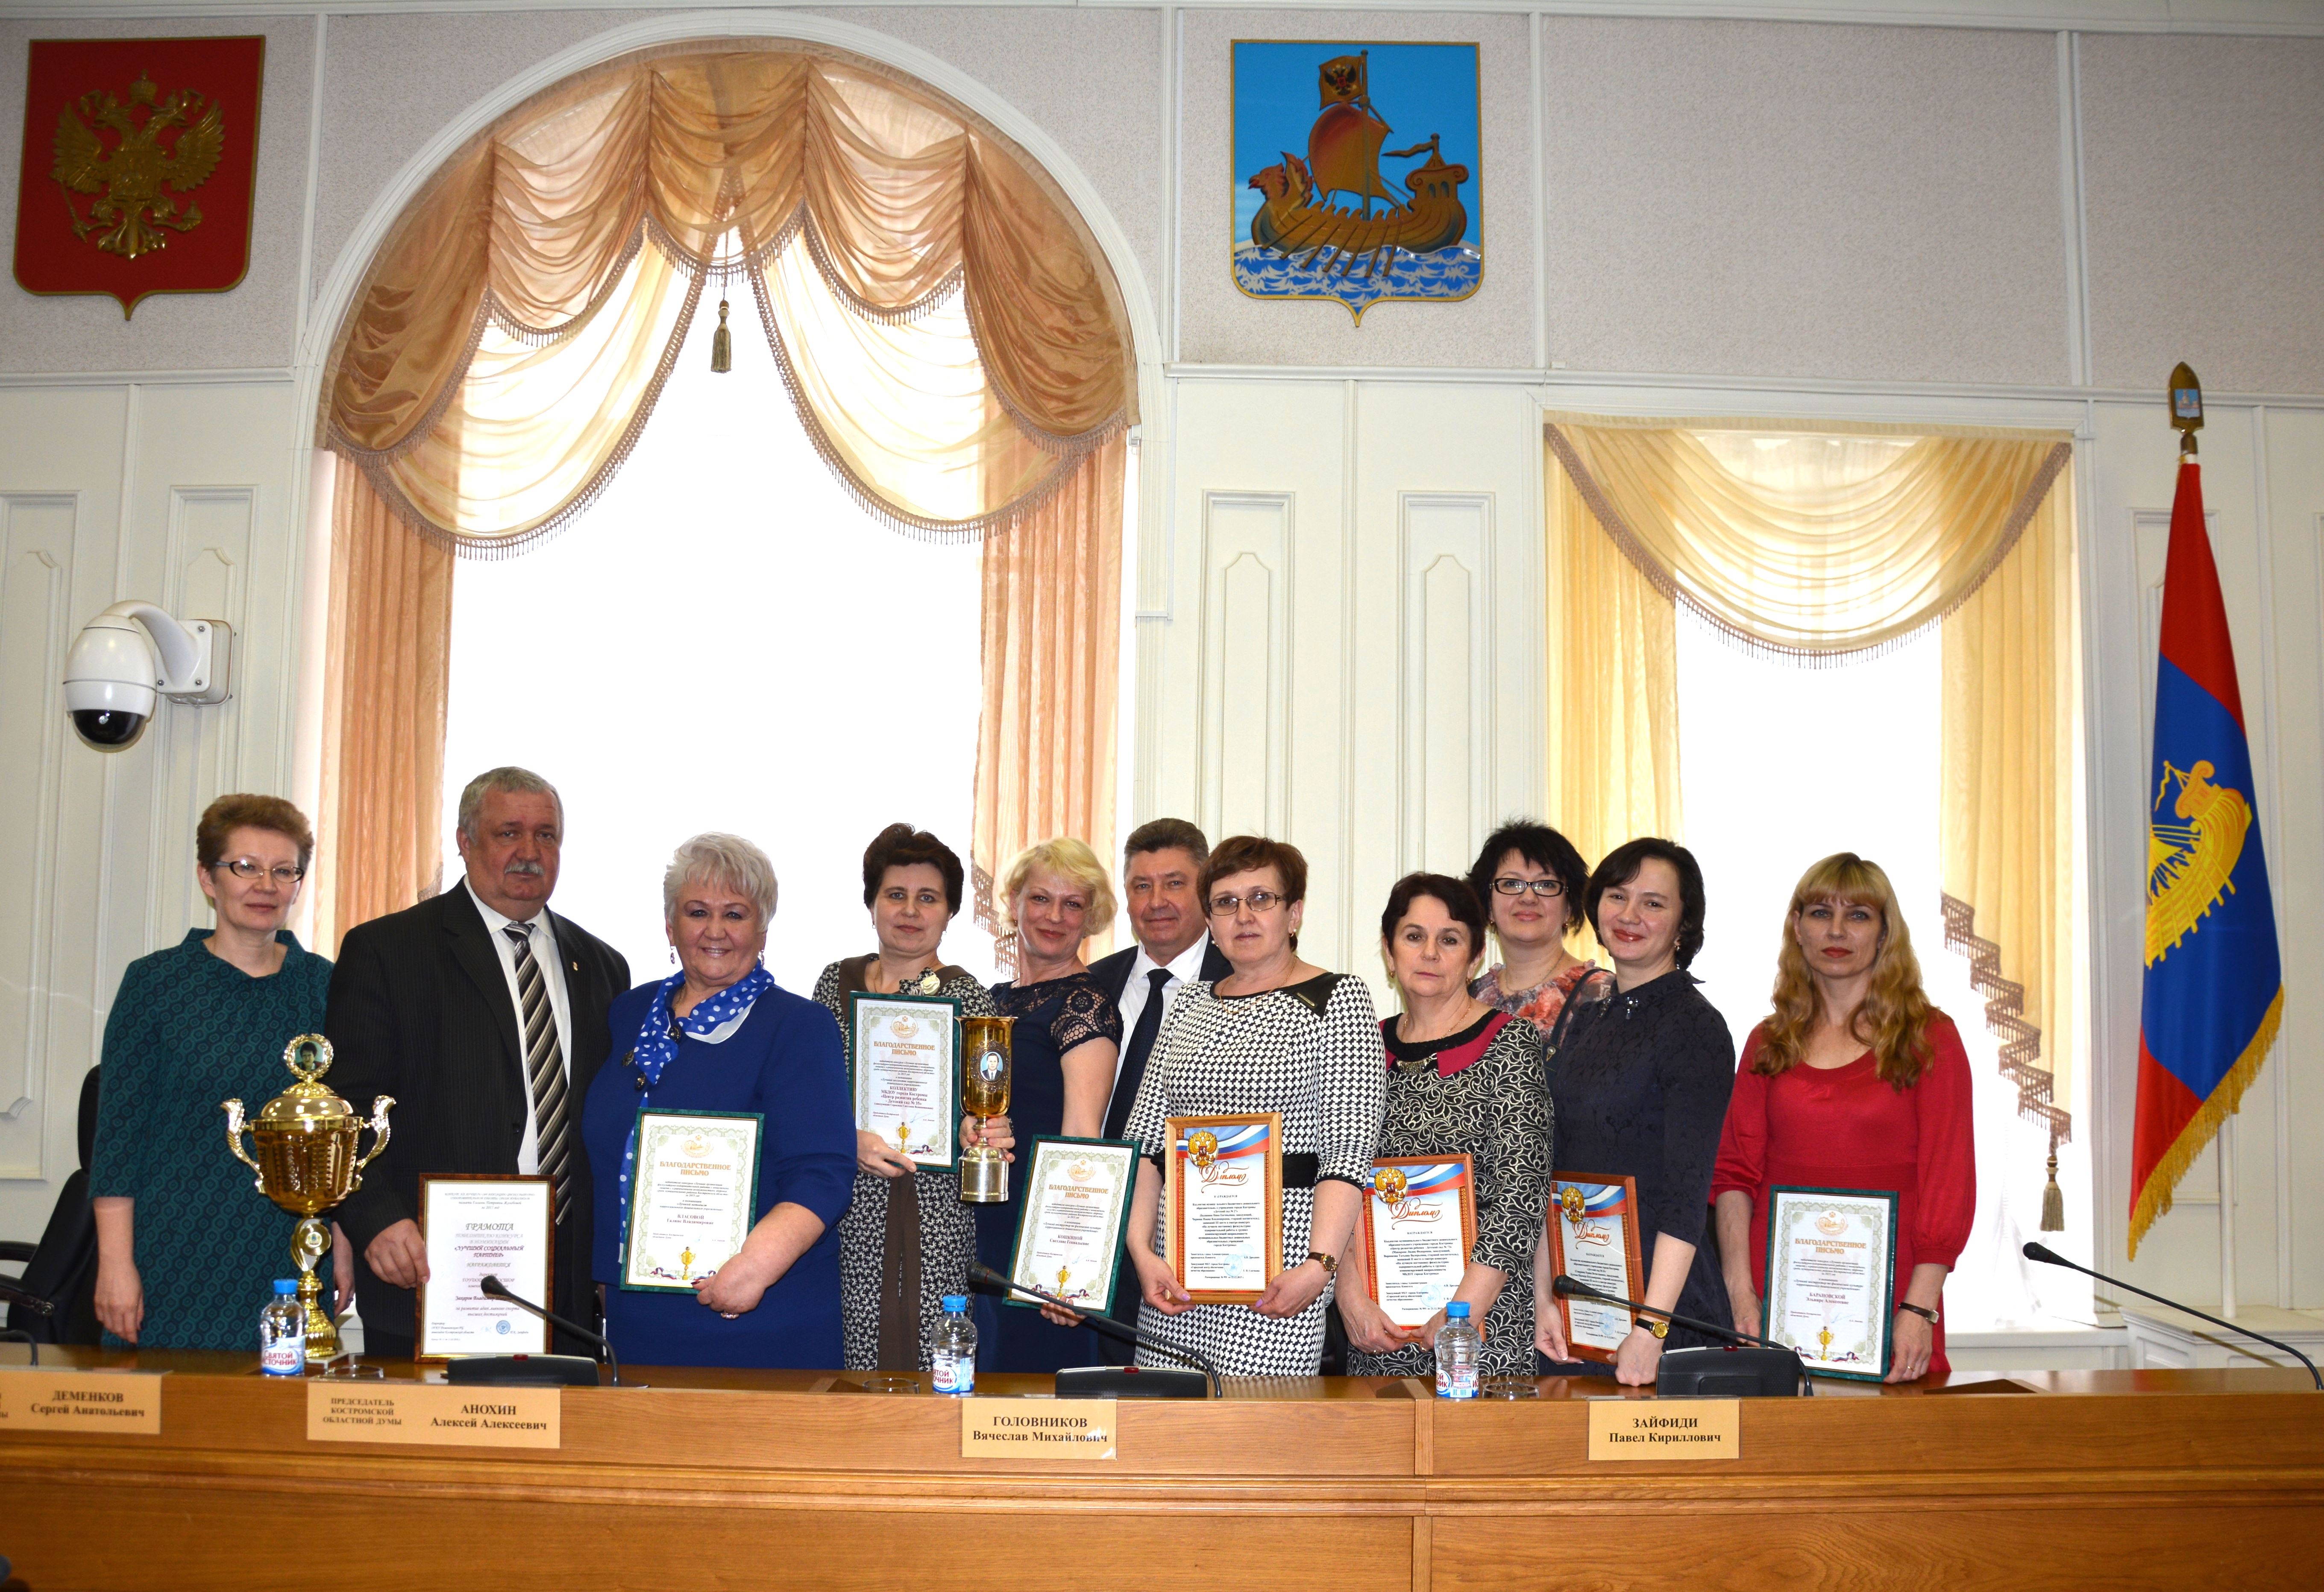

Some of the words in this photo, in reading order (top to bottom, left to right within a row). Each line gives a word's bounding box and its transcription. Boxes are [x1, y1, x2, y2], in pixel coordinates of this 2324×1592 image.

[874, 1041, 935, 1050] БЛАГОДАРСТВЕННОЕ
[660, 1161, 731, 1170] БЛАГОДАРСТВЕННОЕ
[1200, 1162, 1249, 1187] Диплом
[1049, 1184, 1109, 1194] БЛАГОДАРСТВЕННОЕ
[1388, 1198, 1442, 1223] Диплом
[465, 1223, 514, 1231] ГРАМОТА
[1572, 1220, 1611, 1243] Диплом
[1795, 1238, 1866, 1249] БЛАГОДАРСТВЕННОЕ
[264, 1350, 293, 1359] СВЯТОЙ
[262, 1357, 298, 1366] СТОЧНИК
[53, 1390, 124, 1403] ДЕМЕНКОВ
[331, 1398, 394, 1406] ПРЕДСЕДАТЕЛЬ
[31, 1403, 70, 1416] Сергей
[73, 1405, 145, 1417] Анатольевич
[331, 1406, 393, 1416] КОСТРОМСКОЙ
[461, 1404, 516, 1416] АНОХИН
[323, 1415, 374, 1425] ОБЛАСТНОЙ
[376, 1417, 402, 1426] ДУМЫ
[430, 1417, 477, 1428] Алексей
[481, 1419, 547, 1430] Алексеевич
[993, 1416, 1088, 1428] ГОЛОВНИКОВ
[1632, 1416, 1698, 1430] ЗАЙФИДИ
[973, 1430, 1028, 1442] Вячеслав
[1032, 1431, 1108, 1442] Михайлович
[1609, 1433, 1645, 1442] Павел
[1648, 1433, 1721, 1445] Кириллович
